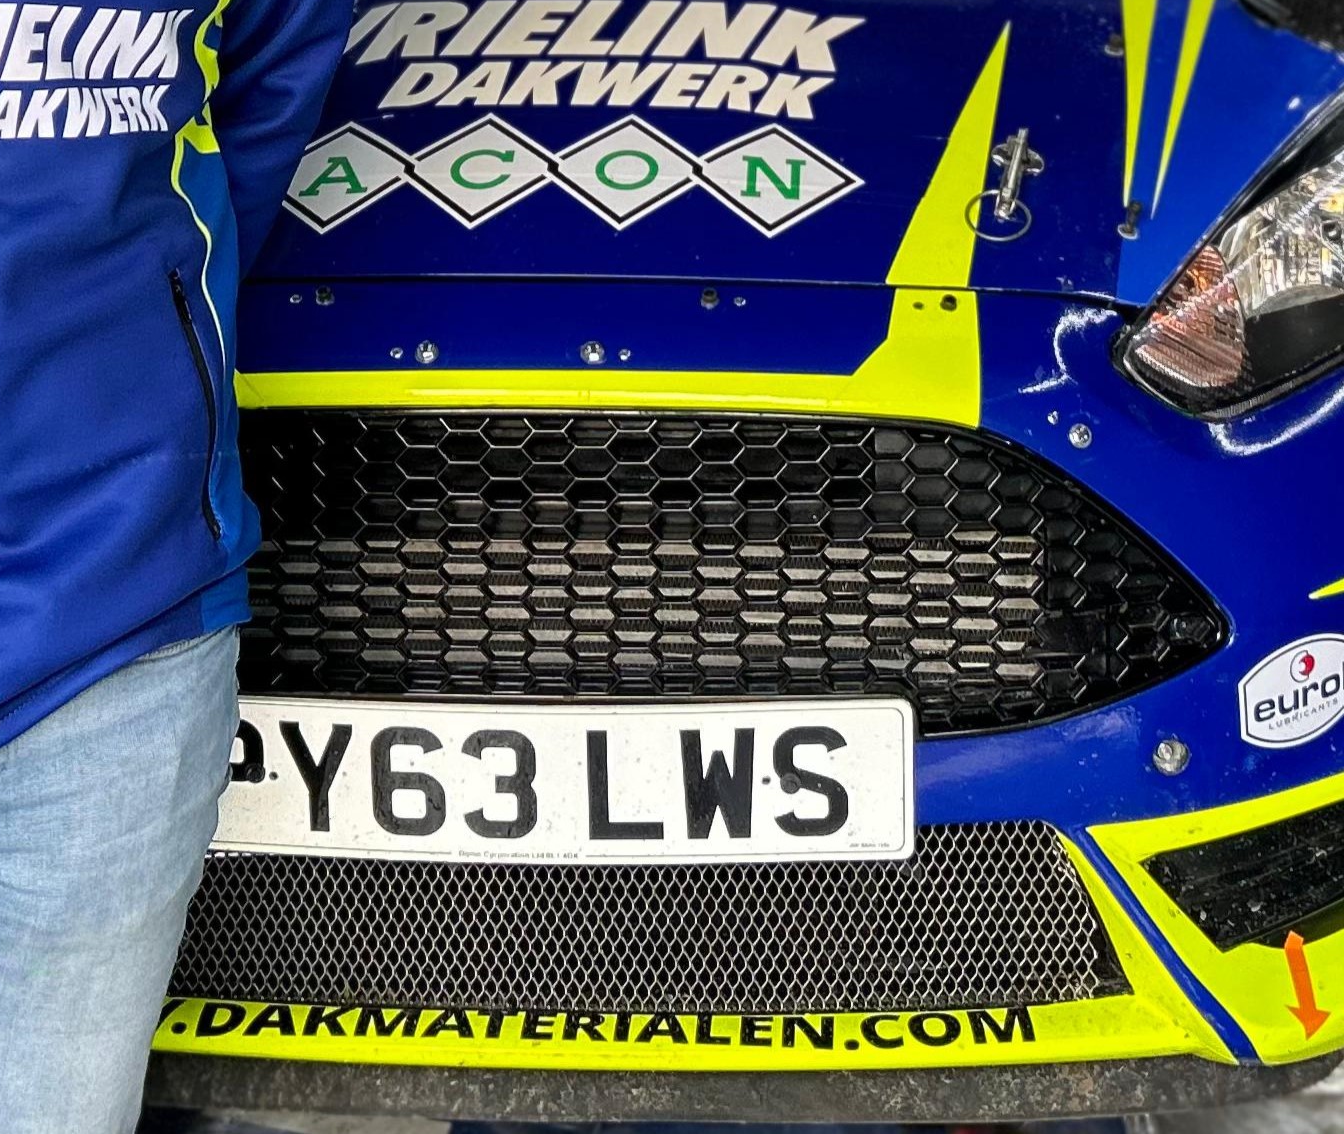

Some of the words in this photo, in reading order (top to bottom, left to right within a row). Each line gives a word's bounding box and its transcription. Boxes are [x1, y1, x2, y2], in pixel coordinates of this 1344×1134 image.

[377, 60, 834, 120] DAKWERK
[298, 148, 806, 201] ACON
[1267, 697, 1340, 731] LUBRICANTS
[586, 724, 850, 841] LWS
